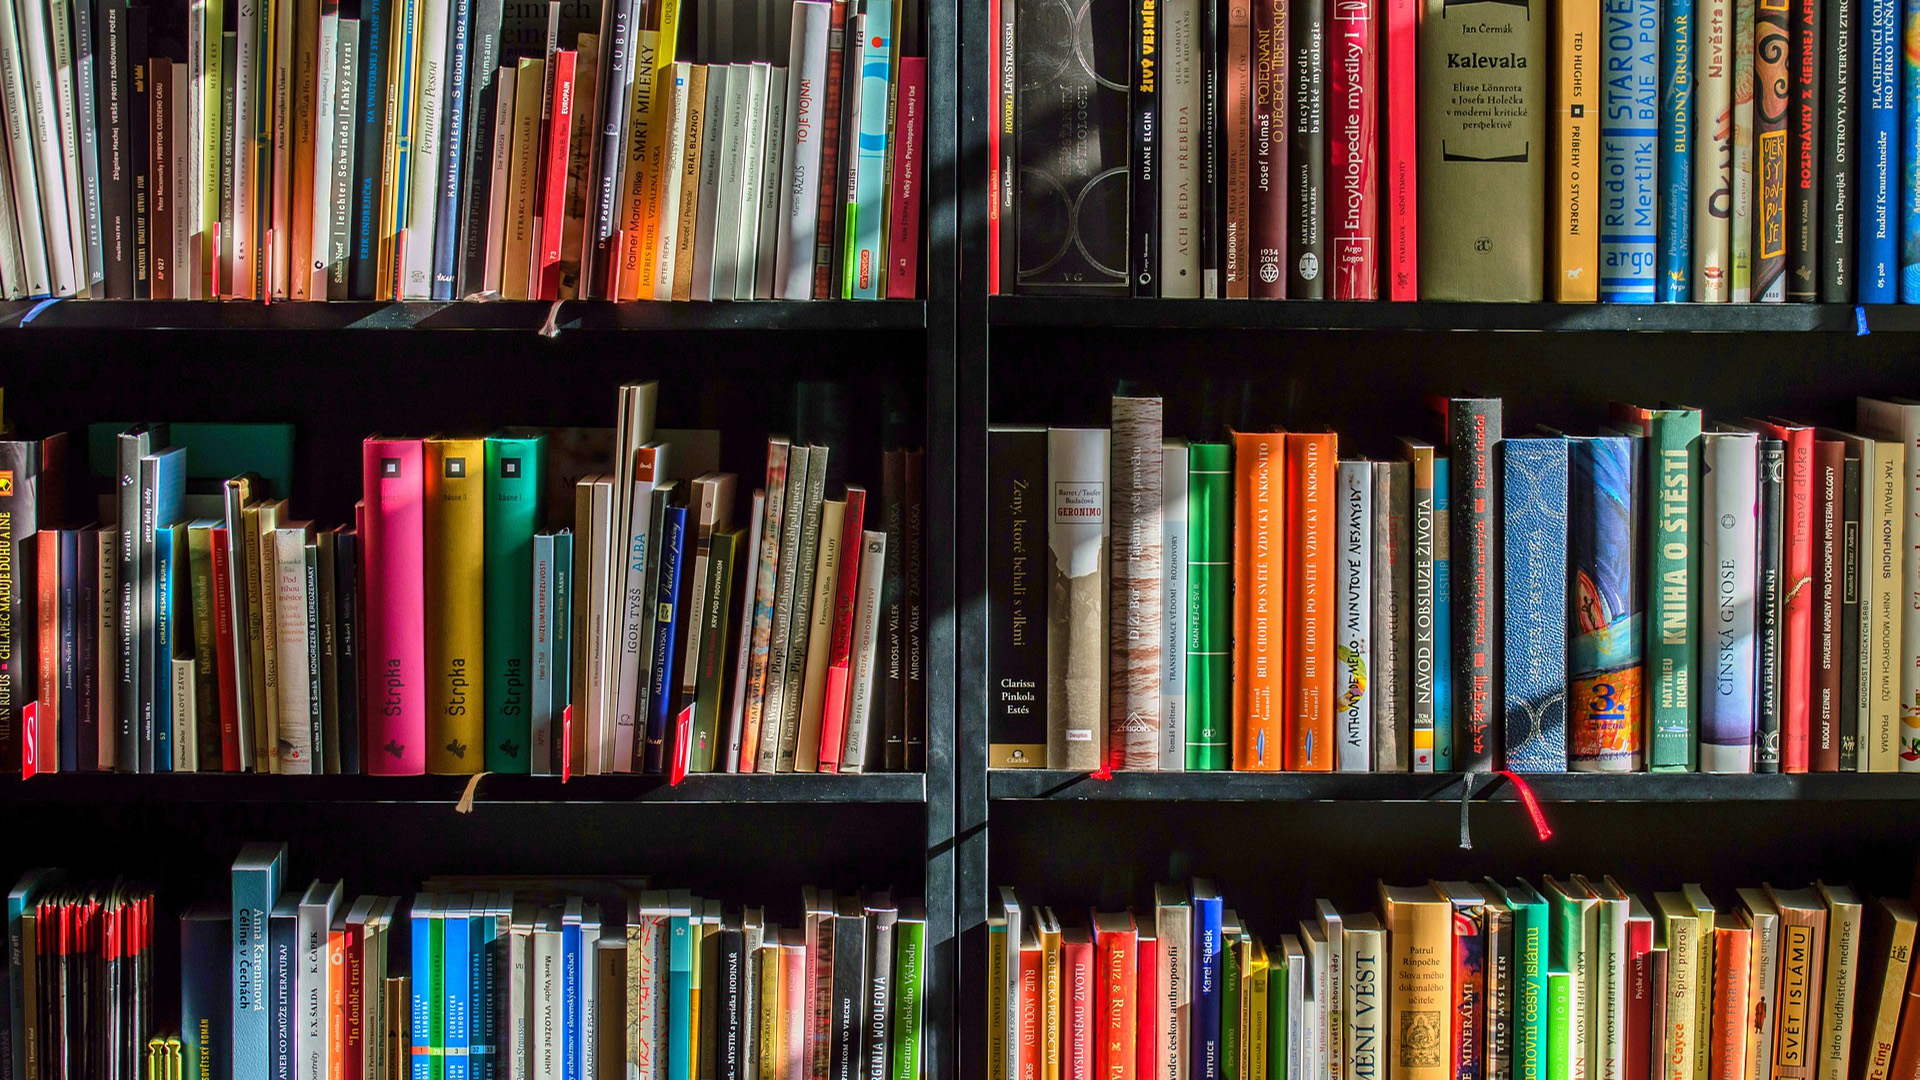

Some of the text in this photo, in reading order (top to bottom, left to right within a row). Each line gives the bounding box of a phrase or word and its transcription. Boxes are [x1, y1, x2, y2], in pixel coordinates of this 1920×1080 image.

[108, 9, 116, 33] POÉZIE
[613, 13, 626, 70] KUBUS
[1462, 23, 1513, 35] Jan Čermák
[109, 34, 118, 79] ZDAŇOVANIU
[341, 42, 352, 76] závrat
[1310, 22, 1322, 133] baltské mytologie
[1345, 42, 1363, 110] mystiky
[1447, 52, 1527, 70] Kalevala
[1573, 32, 1583, 97] TED HUGHES
[1672, 14, 1688, 153] BLUDNÝ BRUSLAŘ
[110, 102, 118, 124] VERŠE
[421, 61, 437, 154] Fernando Pessoa
[799, 79, 810, 115] VOJNA!
[1297, 48, 1310, 133] Encyklopedie
[1453, 83, 1522, 93] Eliase Lönnrota
[1454, 107, 1492, 117] moderní
[1494, 107, 1528, 118] kritické
[1459, 95, 1484, 106] Josefa
[1487, 95, 1523, 105] Holečka
[111, 128, 120, 150] Machej
[337, 120, 349, 177] Schwindel
[687, 109, 699, 149] BLÁZNOV
[797, 117, 810, 128] JE
[797, 130, 807, 144] TO
[1140, 59, 1154, 180] DUANE ELGIN ŽIVÝ
[1463, 119, 1512, 131] perspektivě
[112, 152, 120, 180] Zbigniew
[447, 108, 460, 197] KAMIL PETERAJ
[626, 45, 654, 270] Rainer Maria Rilke SMRŤ MILENKY
[1258, 114, 1270, 192] Josef Kolmaš
[1344, 114, 1363, 230] Encyklopedie
[1570, 126, 1580, 235] PRÍBEHY O STVORENÍ
[88, 176, 96, 220] MAZANEC
[337, 182, 346, 226] leichter
[1605, 142, 1625, 227] Rudolf
[1634, 142, 1653, 227] Mertlík
[360, 178, 372, 259] ERIK ONDREJIČKA
[1606, 250, 1654, 275] argo
[1057, 507, 1102, 517] GERONIMO
[158, 559, 167, 581] BÚRKA
[1255, 442, 1269, 678] BŮH CHODÍ PO SVĚTĚ VŽDYCKY INKOGNITO
[1660, 449, 1688, 645] KNIHA O ŠTĚSTÍ
[100, 540, 112, 628] PÍSEŇ PÍSNÍ
[159, 591, 167, 615] PIESKU
[627, 533, 646, 654] IGOR TYŠŠ ALBA
[710, 560, 723, 628] KRV POD FIGOVNÍKOM
[1414, 499, 1432, 704] NÁVOD K OBSLUZE ŽIVOTA
[159, 622, 167, 645] CHRÁM
[888, 603, 900, 679] MIROSLAV VÁLEK
[1167, 534, 1178, 754] Tomáš Keltner TRANSFORMACE VĚDOMÍ ROZHOVORY
[1716, 559, 1735, 696] ČÍNSKÁ GNOSE
[1762, 569, 1776, 715] FRATERNITAS SATURNI
[382, 659, 405, 716] Štrpka
[444, 658, 468, 716] Štrpka
[499, 658, 524, 716] Štrpka
[655, 627, 668, 695] ALFRED TENNYSON
[1001, 678, 1036, 688] Clarissa
[1662, 658, 1674, 708] MATTHIEU
[1676, 670, 1688, 708] RICARD
[176, 666, 186, 727] PERLOVÝ ZÁVES
[854, 682, 866, 724] Boris Vian
[1001, 692, 1035, 701] Pinkola
[1007, 705, 1030, 714] Estés
[239, 908, 249, 945] Céline
[309, 931, 318, 962] ČAPEK
[239, 960, 252, 1009] Čechách
[253, 908, 265, 1011] Anna Kareninová
[311, 964, 318, 973] K.
[1525, 927, 1541, 1022] cesty islámu
[1675, 928, 1688, 998] Spící prorok
[278, 944, 287, 1053] CO ZMŮŽE LITERATURA?
[310, 988, 318, 1017] ŠALDA
[349, 988, 360, 1025] double
[872, 976, 886, 1038] WOOLFOVÁ
[901, 944, 917, 1079] literatury arabského Východu
[1168, 946, 1178, 1051] českou anthroposofií
[1203, 930, 1214, 1078] INTUICE Karel Sládek
[1785, 933, 1805, 1060] SVĚT ISLÁMU
[1830, 921, 1851, 1061] Jádro buddhistické meditace
[311, 1019, 318, 1028] X.
[1460, 983, 1474, 1067] MINERÁLMI
